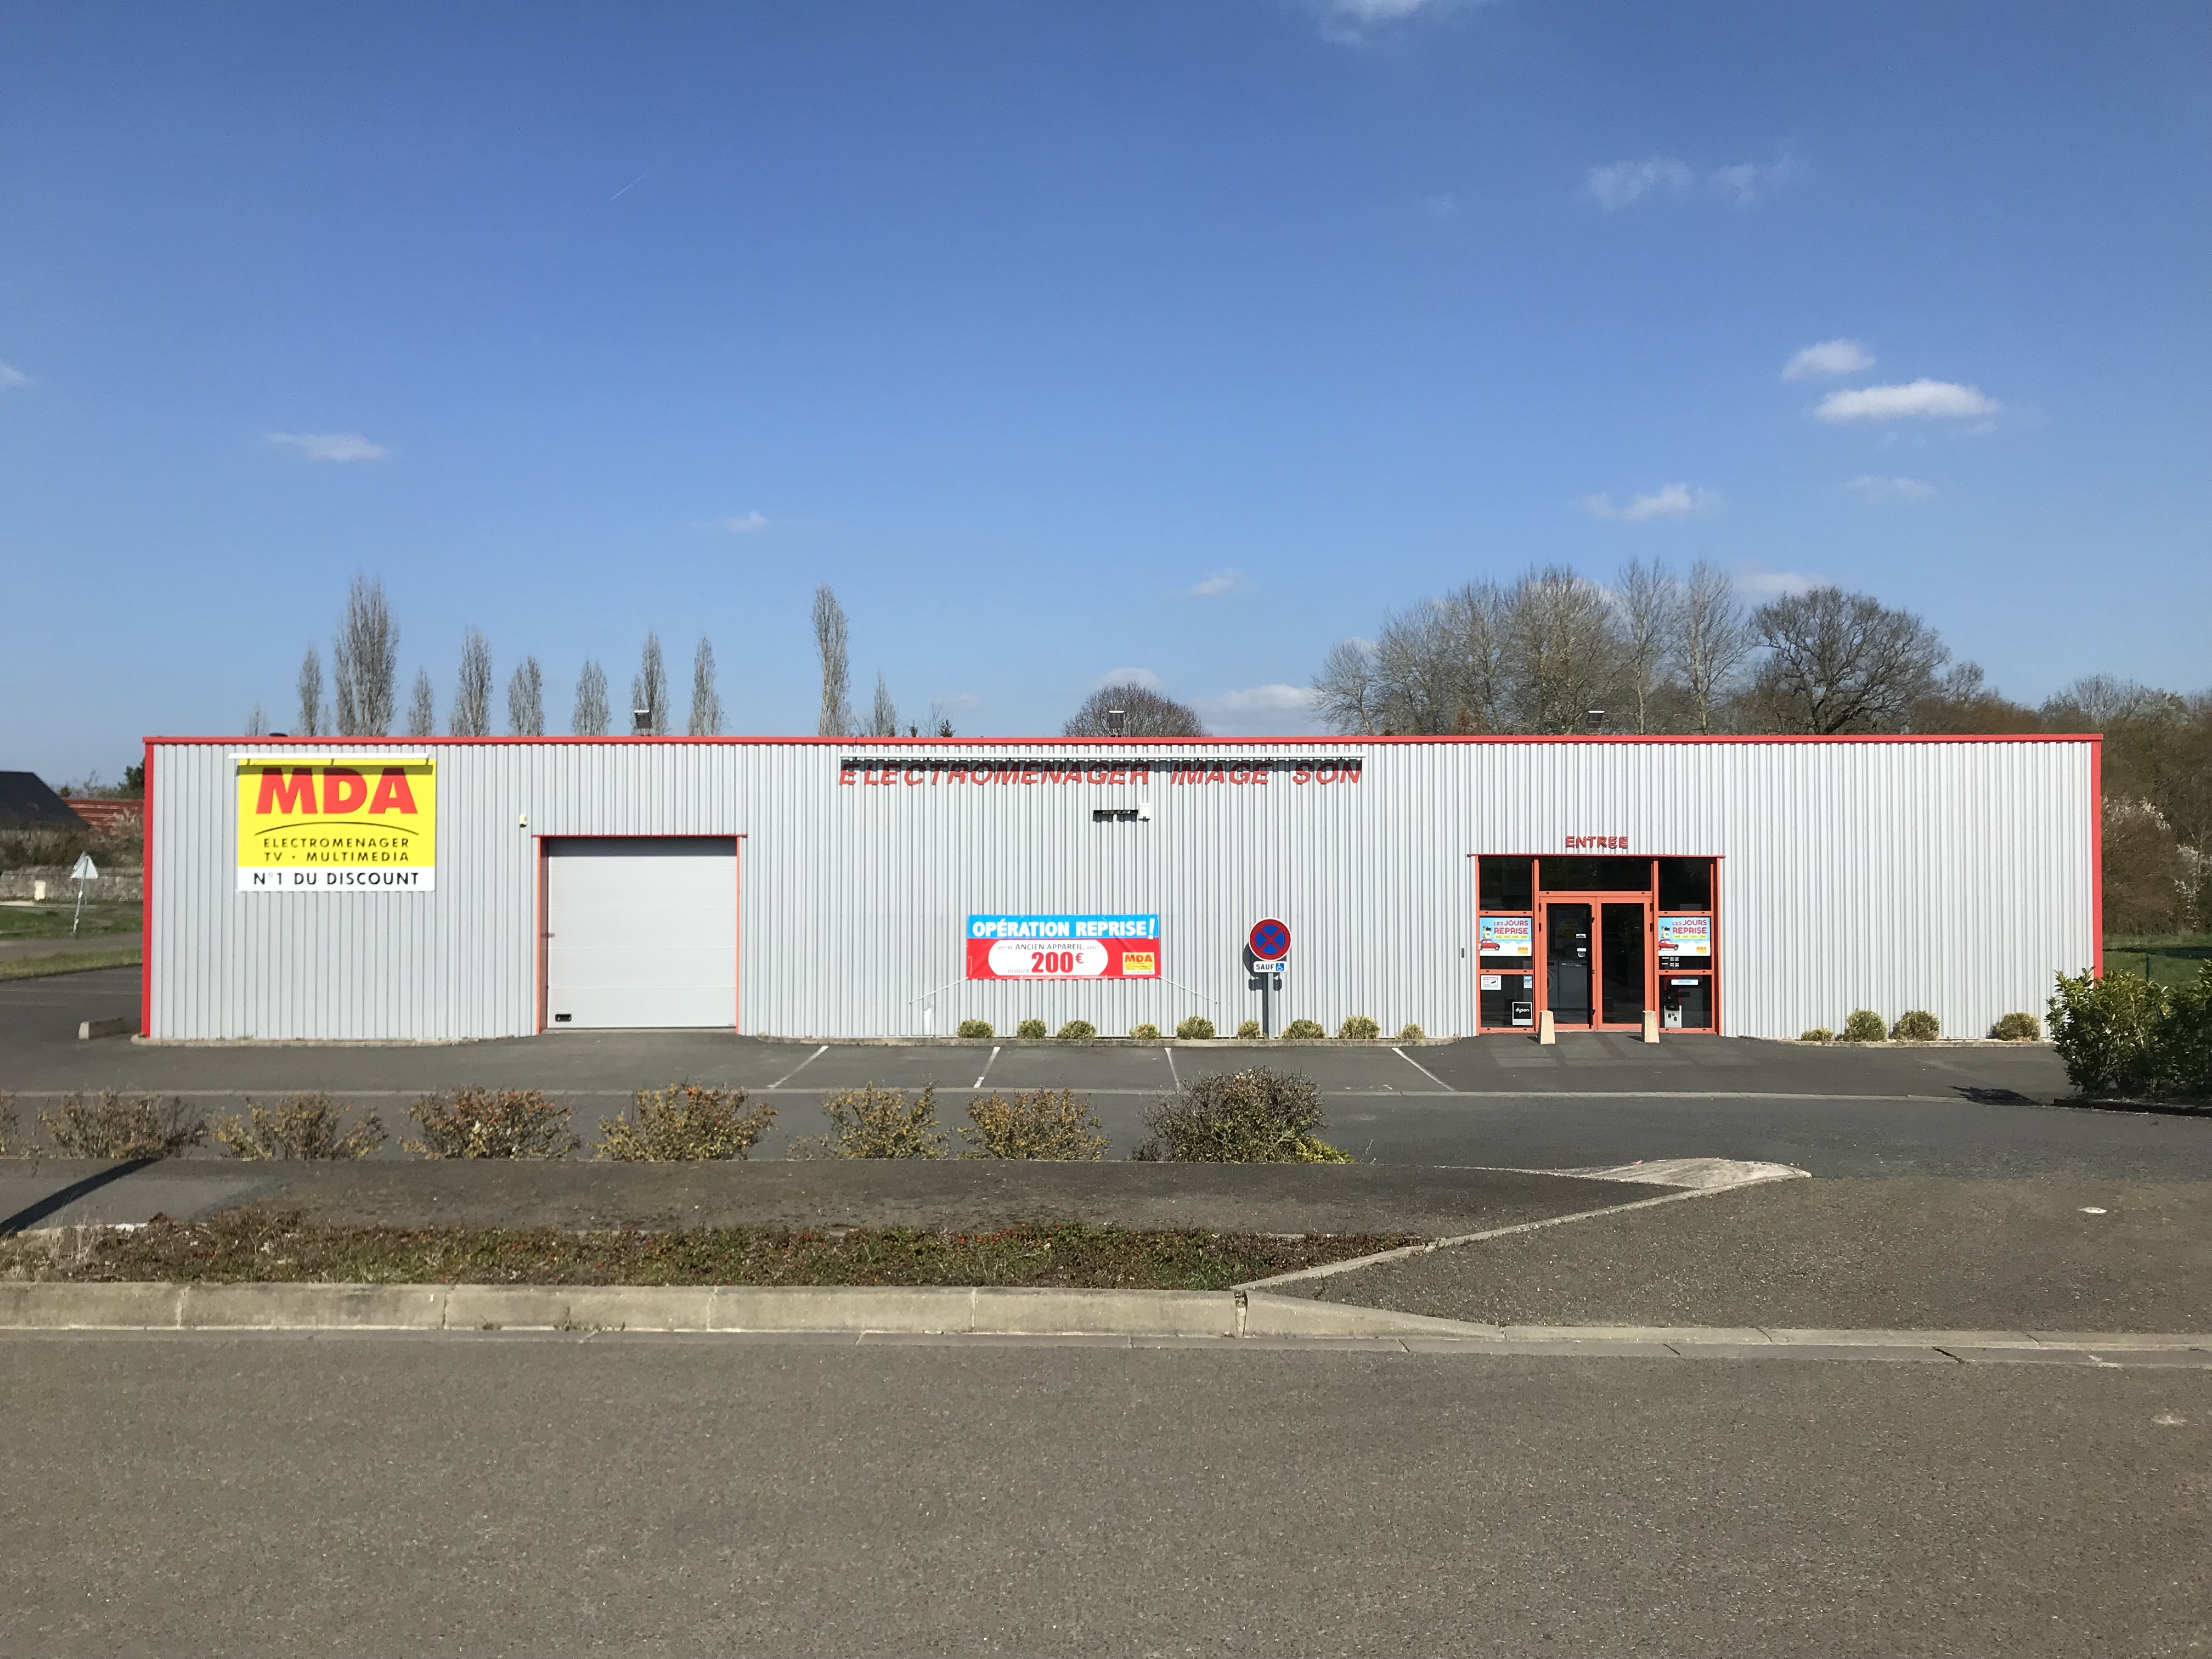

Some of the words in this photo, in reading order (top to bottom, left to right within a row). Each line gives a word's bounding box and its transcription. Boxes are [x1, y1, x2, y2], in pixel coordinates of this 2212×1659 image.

[839, 762, 1150, 785] ELECTROMENAGER
[1170, 762, 1272, 785] IMAGE
[1292, 762, 1362, 785] SON
[255, 767, 418, 815] MDA
[263, 838, 409, 848] ELECTROMENAGER
[1566, 836, 1628, 849] ENTREE
[264, 852, 282, 861] TV
[306, 852, 409, 861] MULTIMEDIA
[294, 872, 317, 884] DU
[327, 872, 419, 885] DISCOUNT
[972, 918, 1069, 937] OPÉRATION
